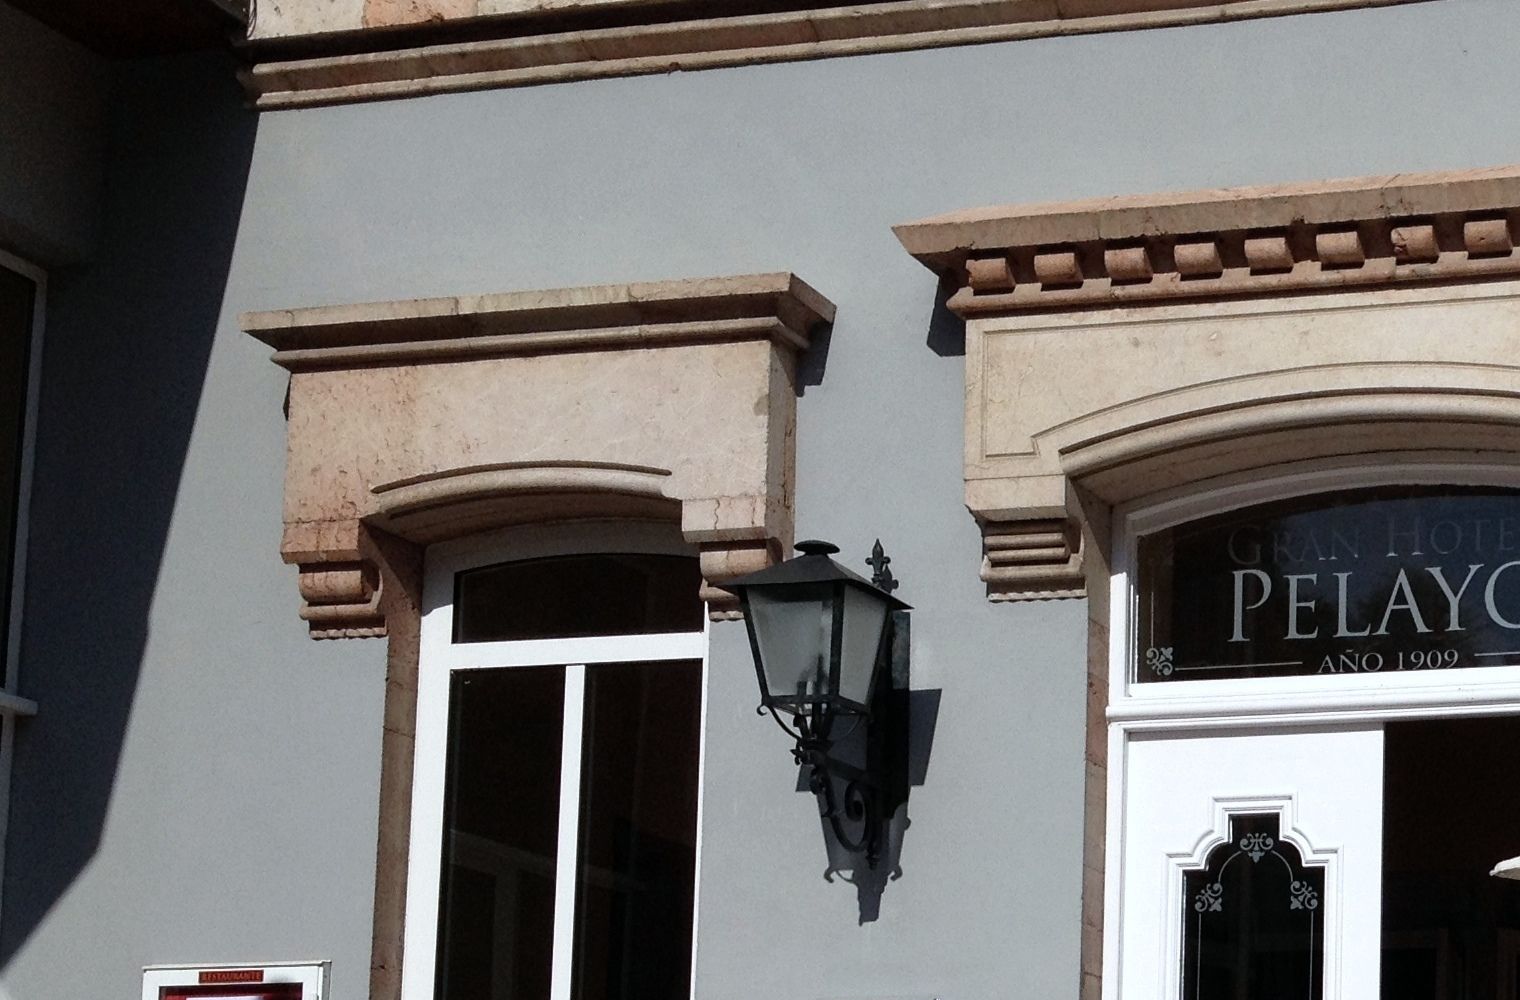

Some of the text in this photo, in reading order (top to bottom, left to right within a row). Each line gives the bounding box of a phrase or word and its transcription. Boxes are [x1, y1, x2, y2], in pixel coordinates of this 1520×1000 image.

[1227, 521, 1360, 566] GRAN
[1318, 648, 1460, 674] AÑO 1909
[202, 971, 262, 982] RESTAURANTE
